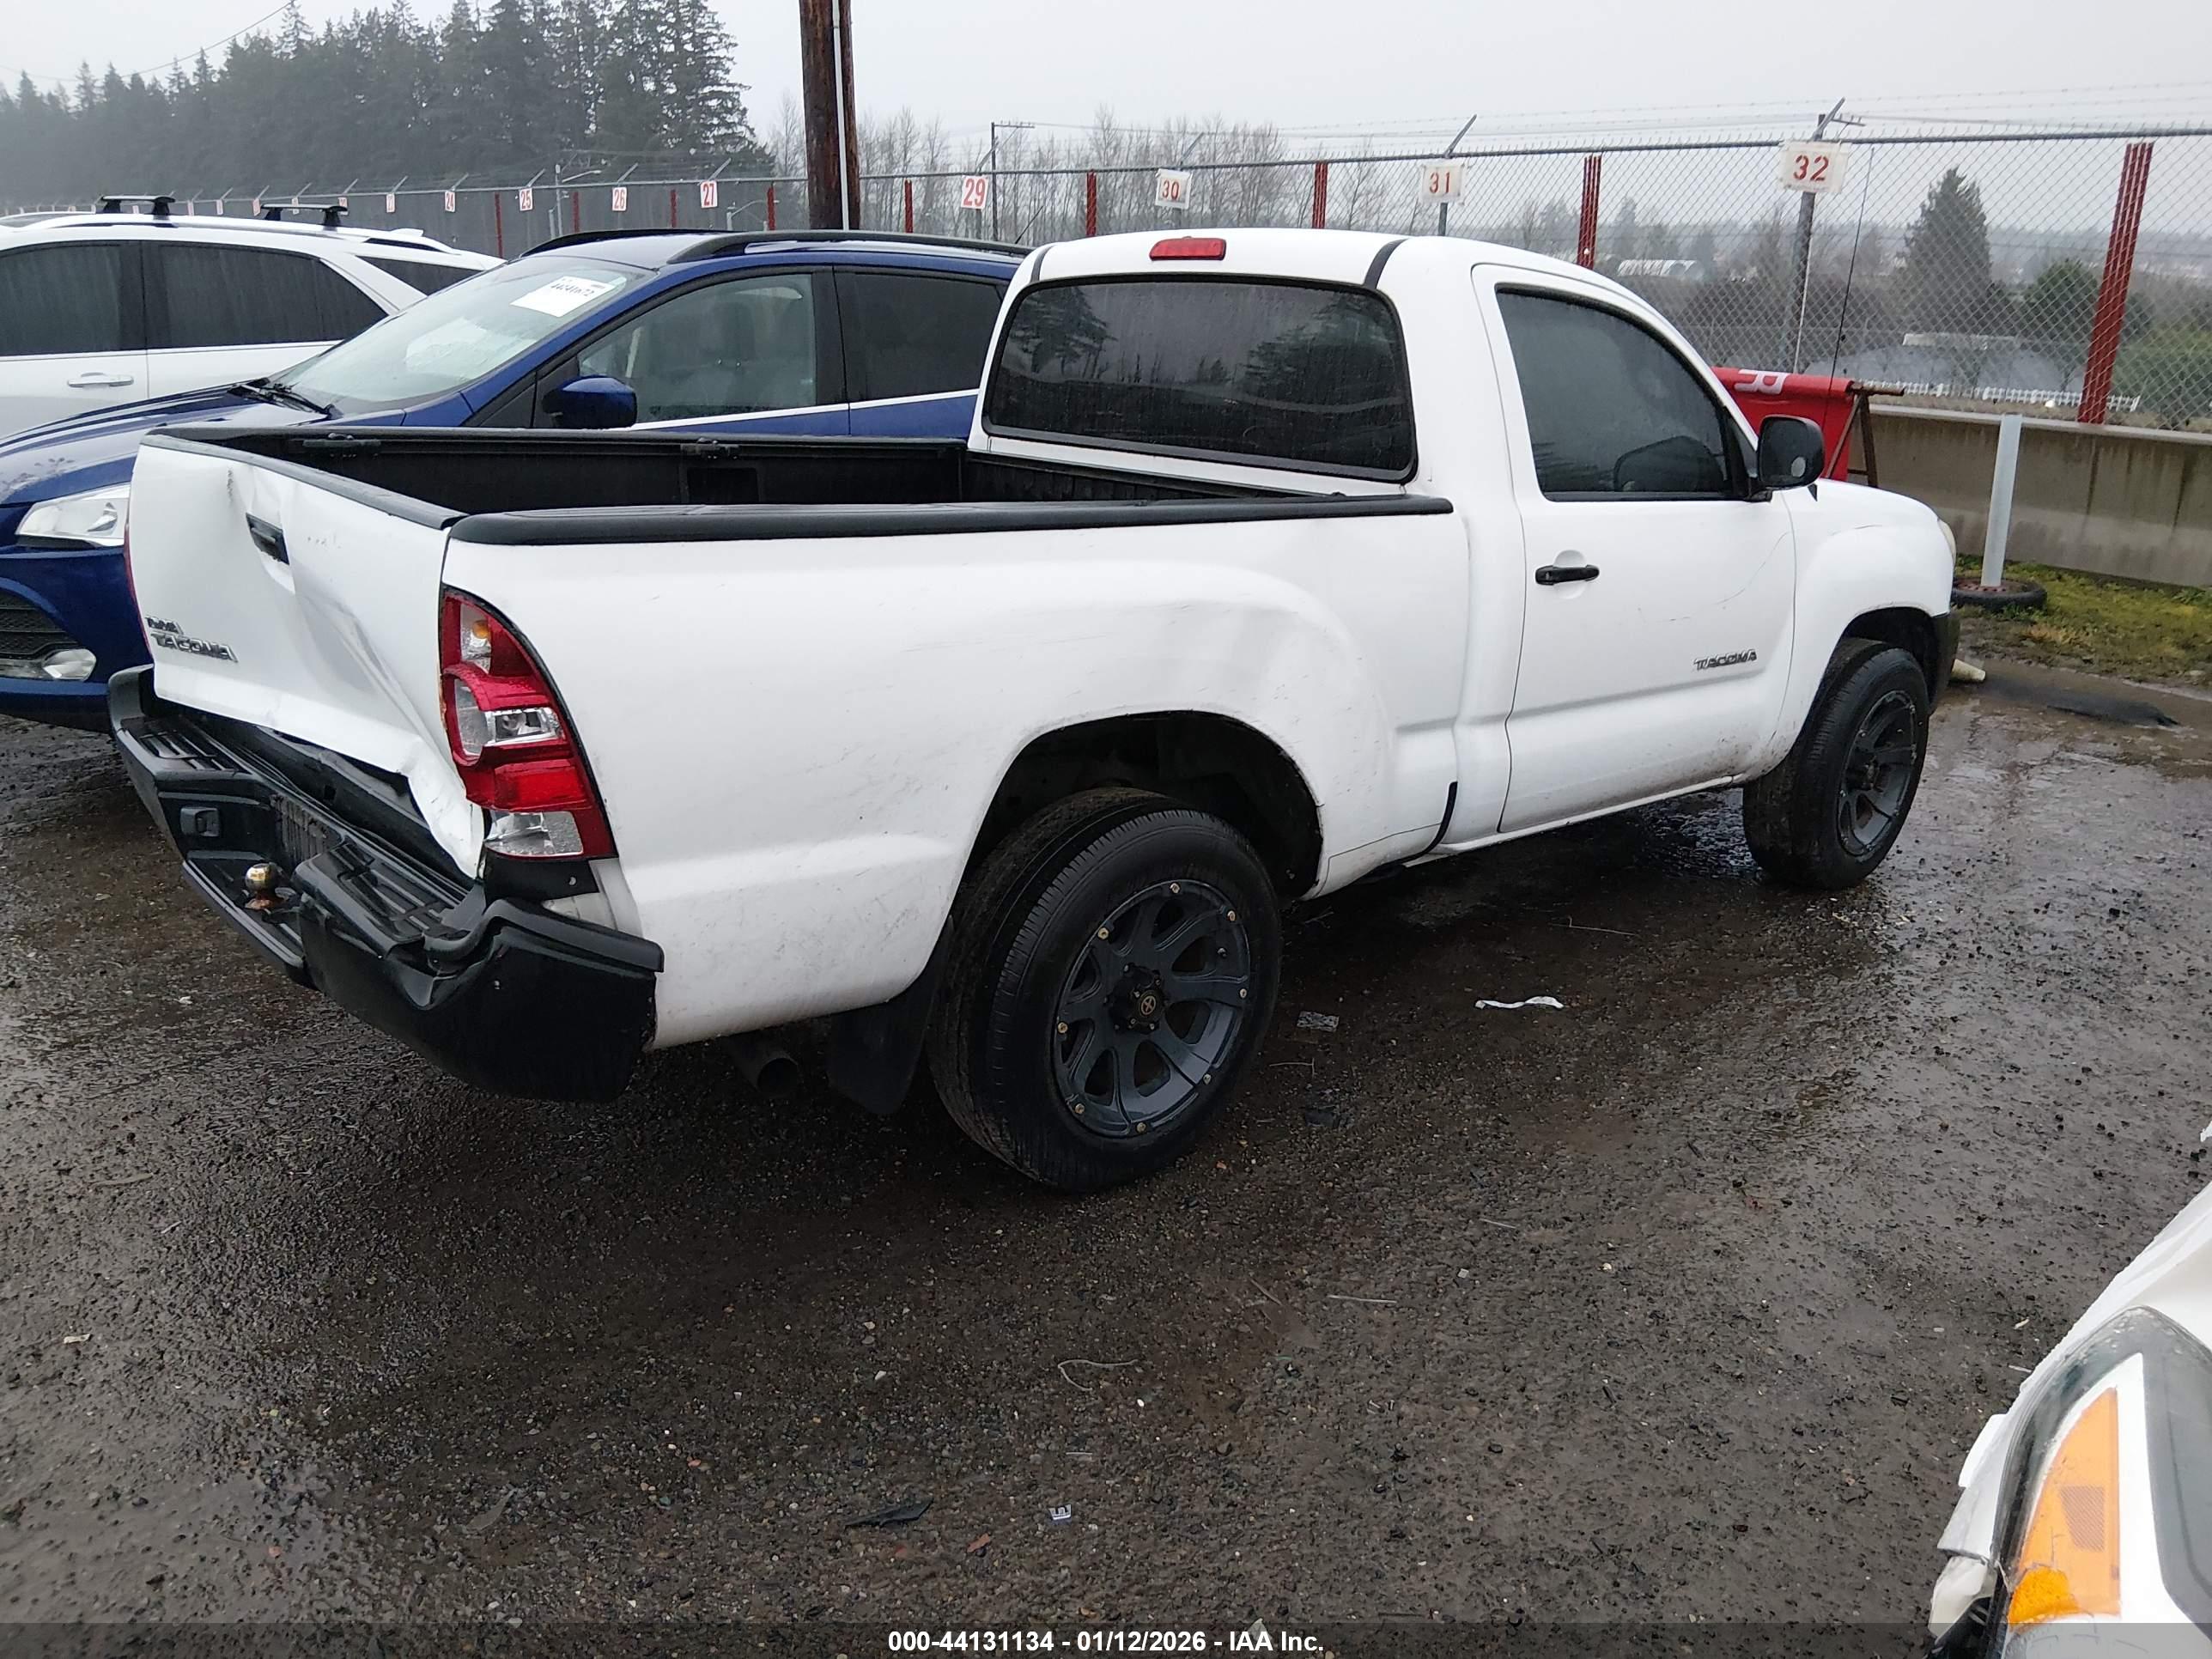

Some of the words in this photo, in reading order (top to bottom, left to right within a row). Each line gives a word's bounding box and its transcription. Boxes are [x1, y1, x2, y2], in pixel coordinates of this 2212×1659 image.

[1793, 155, 1829, 182] 32
[702, 183, 714, 206] 27
[963, 178, 987, 206] 29
[1162, 180, 1180, 200] 30
[1429, 172, 1450, 194] 31
[520, 190, 532, 210] 25
[614, 189, 625, 210] 26
[150, 631, 239, 664] TACOMA
[1693, 648, 1758, 671] TACOMA
